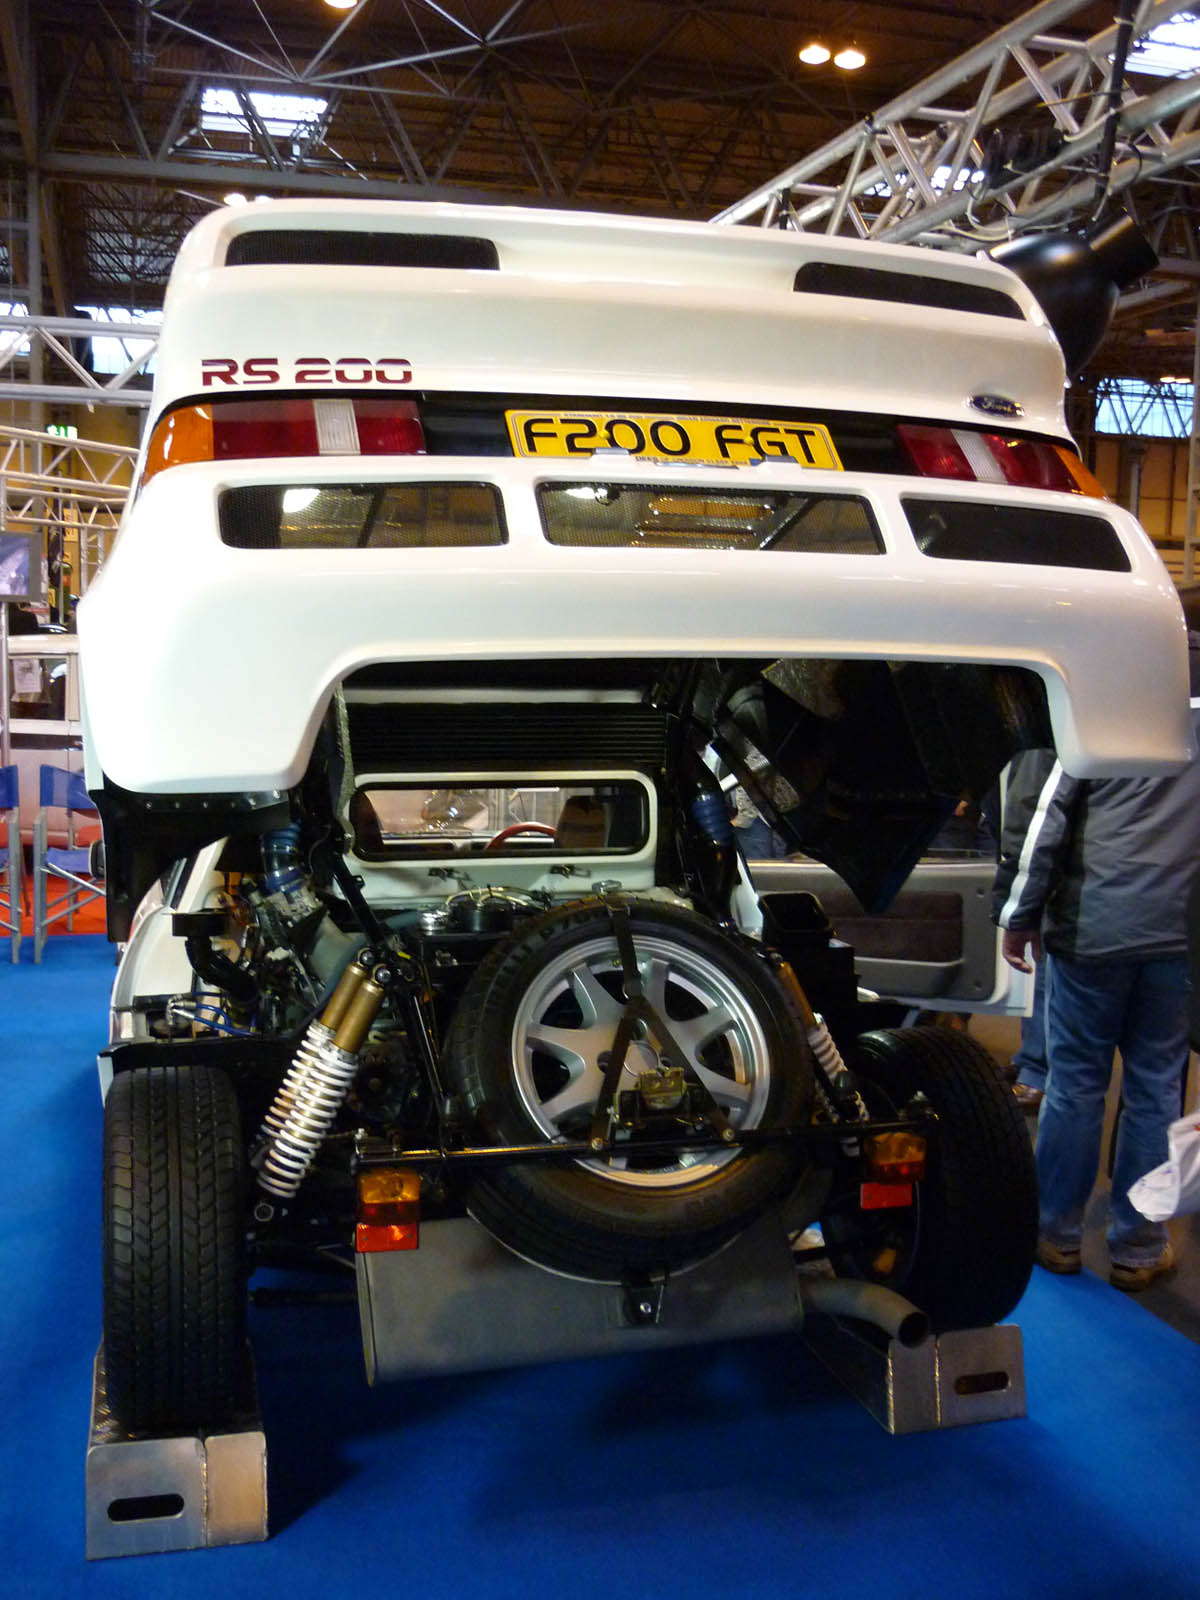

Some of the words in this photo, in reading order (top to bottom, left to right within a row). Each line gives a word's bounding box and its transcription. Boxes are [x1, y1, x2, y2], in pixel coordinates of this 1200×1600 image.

[201, 357, 281, 386] RS
[294, 357, 413, 384] 200
[522, 417, 692, 457] F200
[714, 424, 818, 465] FGT
